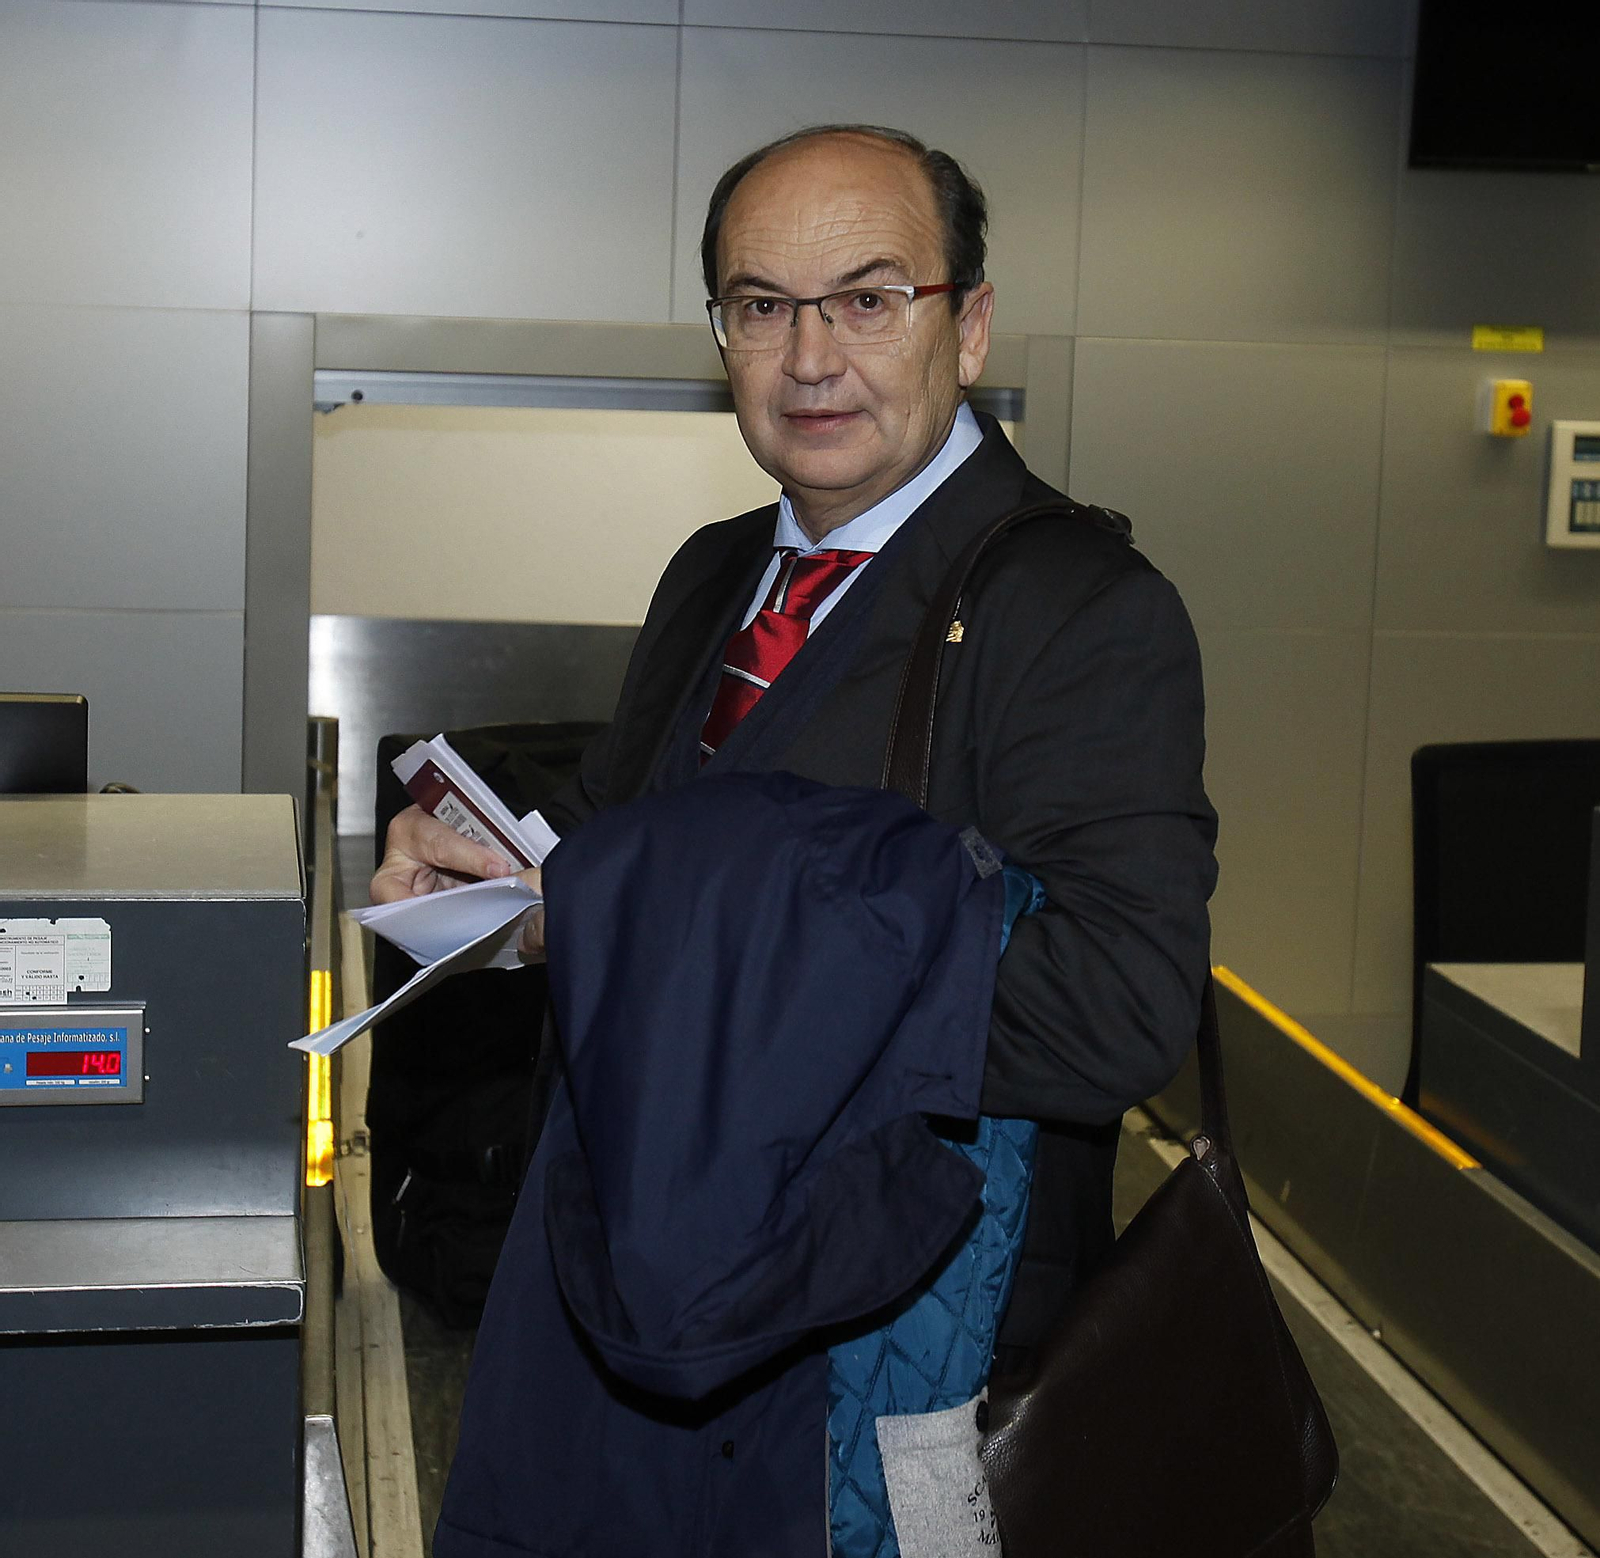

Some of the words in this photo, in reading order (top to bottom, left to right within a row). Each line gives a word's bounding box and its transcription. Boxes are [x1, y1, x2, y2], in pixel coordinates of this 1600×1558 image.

[16, 1032, 25, 1043] de
[27, 1032, 51, 1045] Pesaje
[109, 1031, 120, 1043] s.l.
[82, 1053, 121, 1074] 14.0
